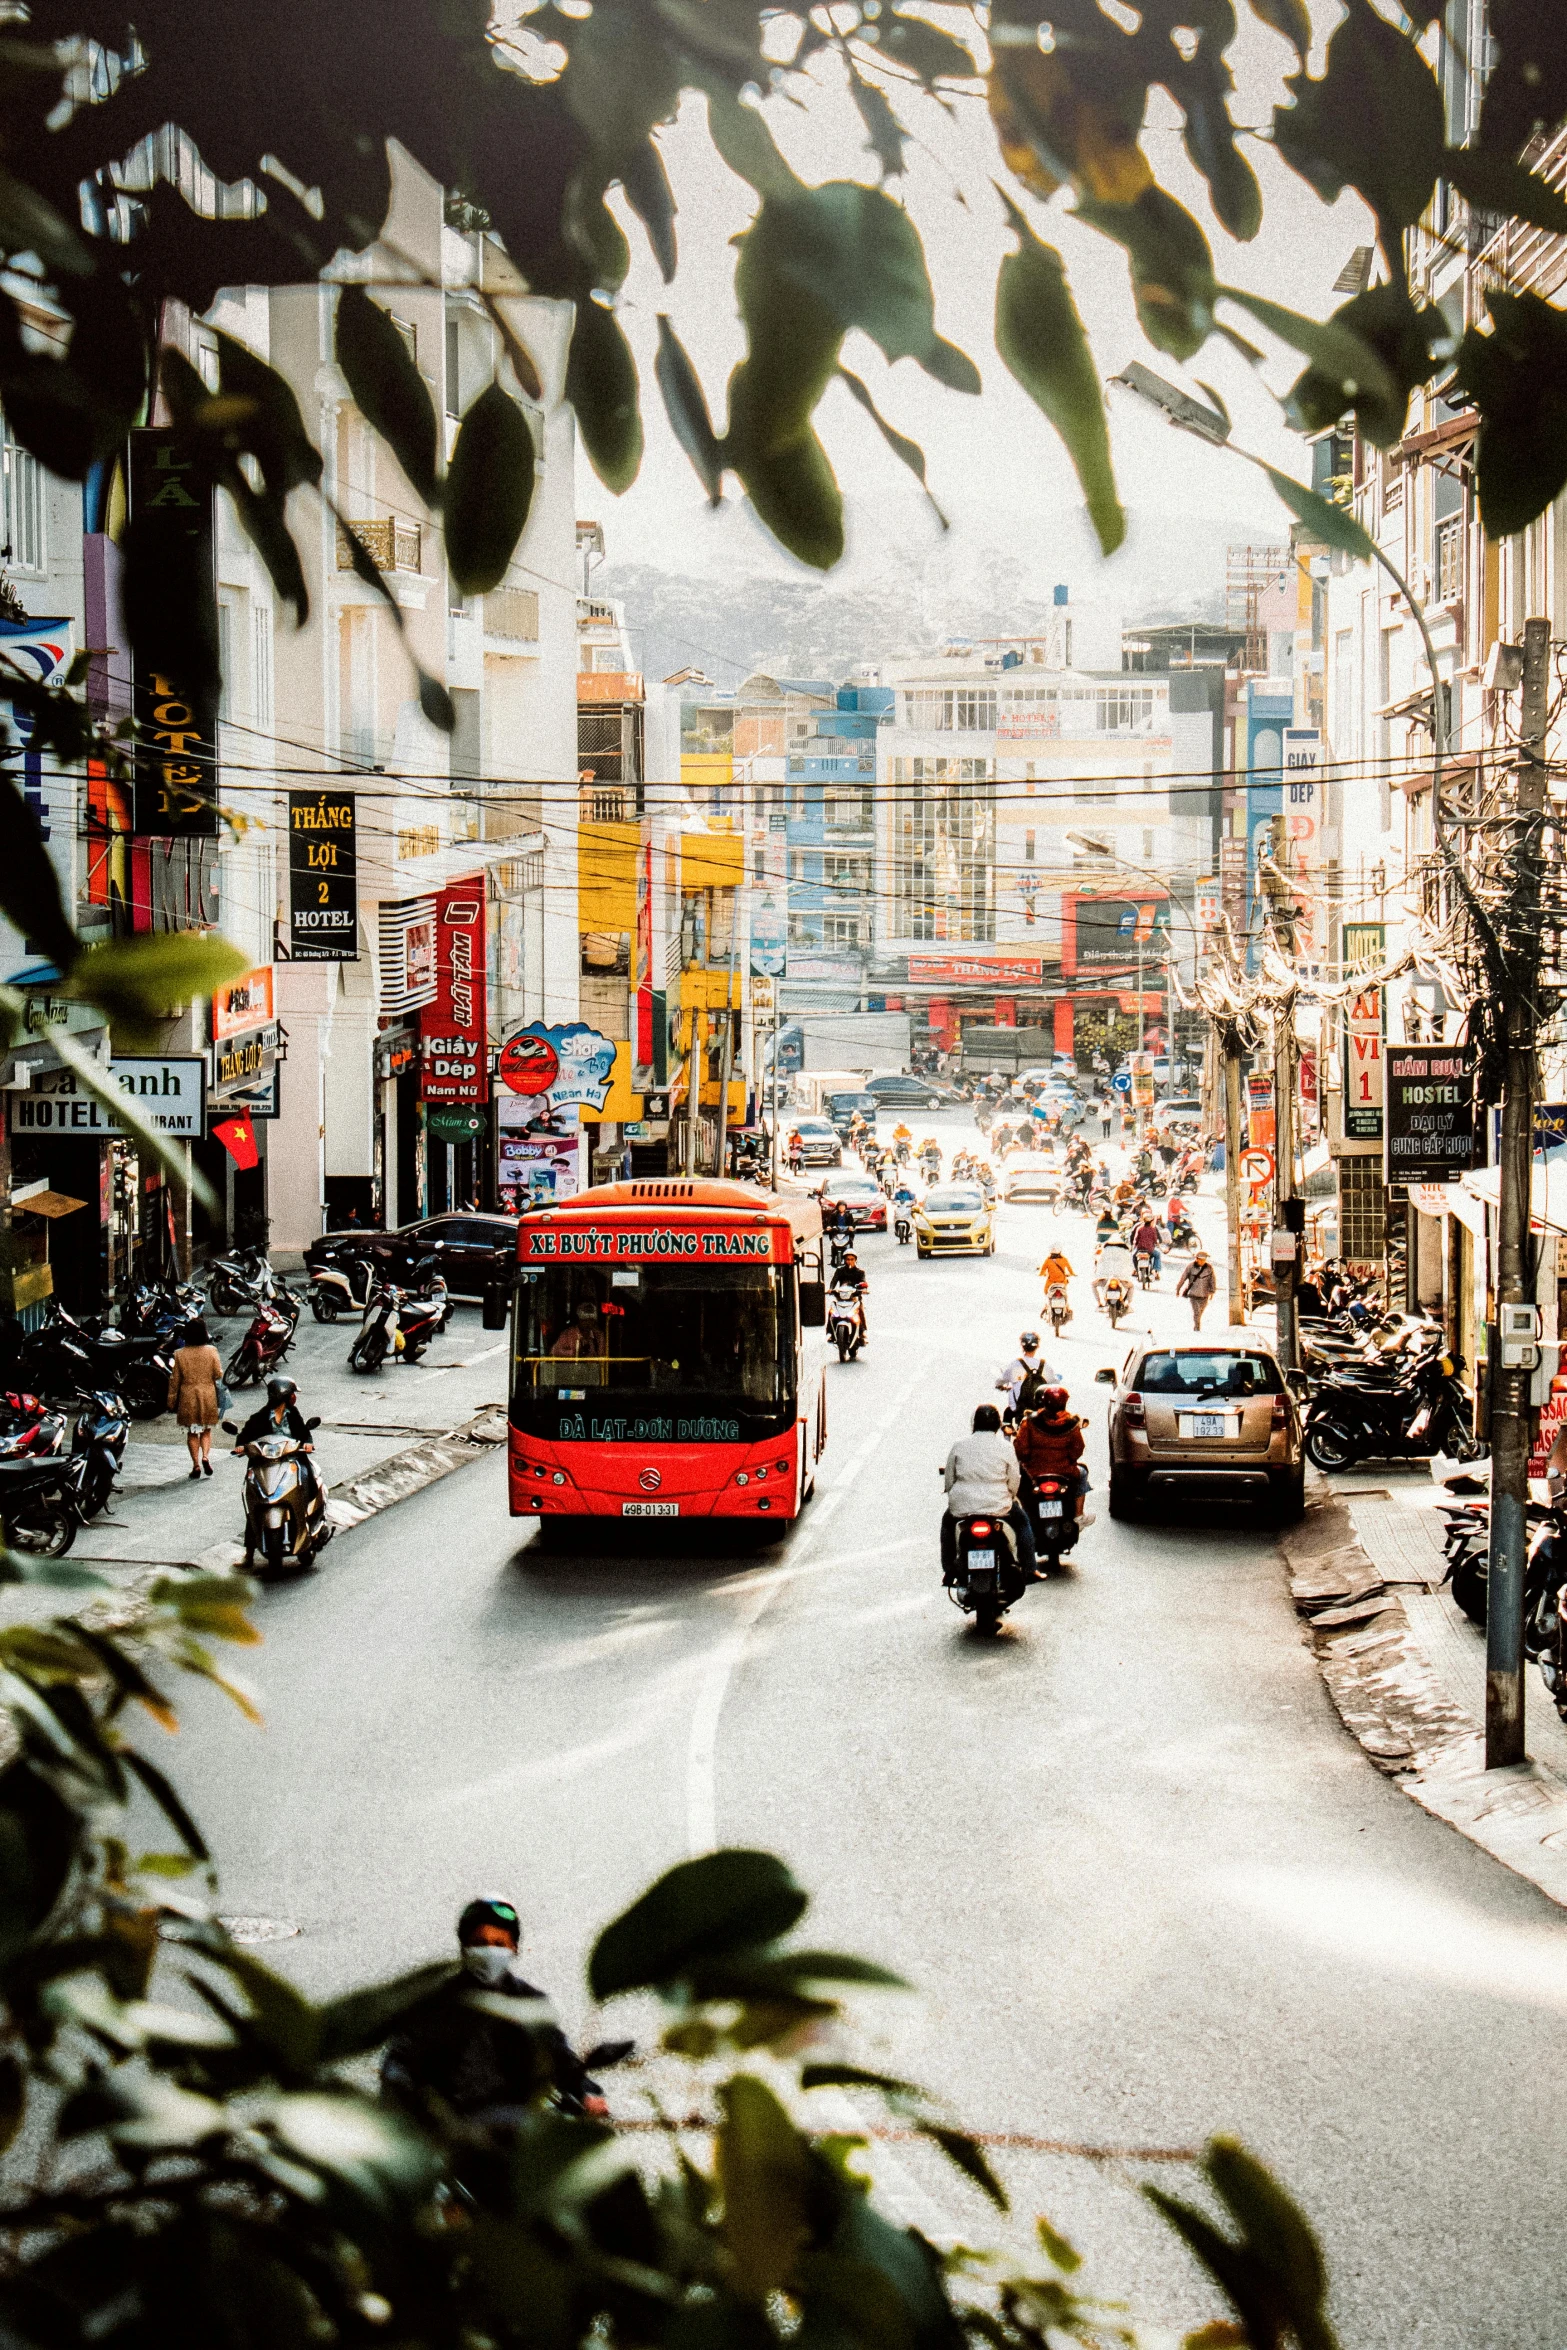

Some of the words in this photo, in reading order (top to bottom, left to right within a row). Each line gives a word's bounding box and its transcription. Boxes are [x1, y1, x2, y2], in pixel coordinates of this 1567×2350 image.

[292, 795, 352, 829] THẮNG
[308, 841, 338, 871] LỢI
[318, 882, 330, 904] 2
[294, 910, 354, 927] HOTEL
[450, 931, 473, 981] TÂM
[1347, 930, 1382, 969] HOTEL
[430, 1035, 478, 1058] Giầy
[560, 1036, 600, 1058] Shop
[1353, 1032, 1380, 1060] VI
[435, 1060, 476, 1079] Dép
[427, 1085, 456, 1095] Nam
[459, 1085, 478, 1096] Nữ
[1360, 1071, 1373, 1100] 1
[1402, 1086, 1462, 1104] HOSTEL
[19, 1100, 102, 1127] HOTEL
[504, 1144, 542, 1157] Bobby
[1391, 1137, 1421, 1156] CUNG
[1422, 1132, 1445, 1155] CẤP
[529, 1233, 556, 1254] XE
[559, 1228, 613, 1255] BUÝT
[617, 1228, 698, 1255] PHƯƠNG
[702, 1233, 770, 1255] TRANG
[560, 1413, 586, 1439] ĐÀ
[678, 1416, 740, 1440] DƯƠNG
[1201, 1416, 1217, 1426] 49A
